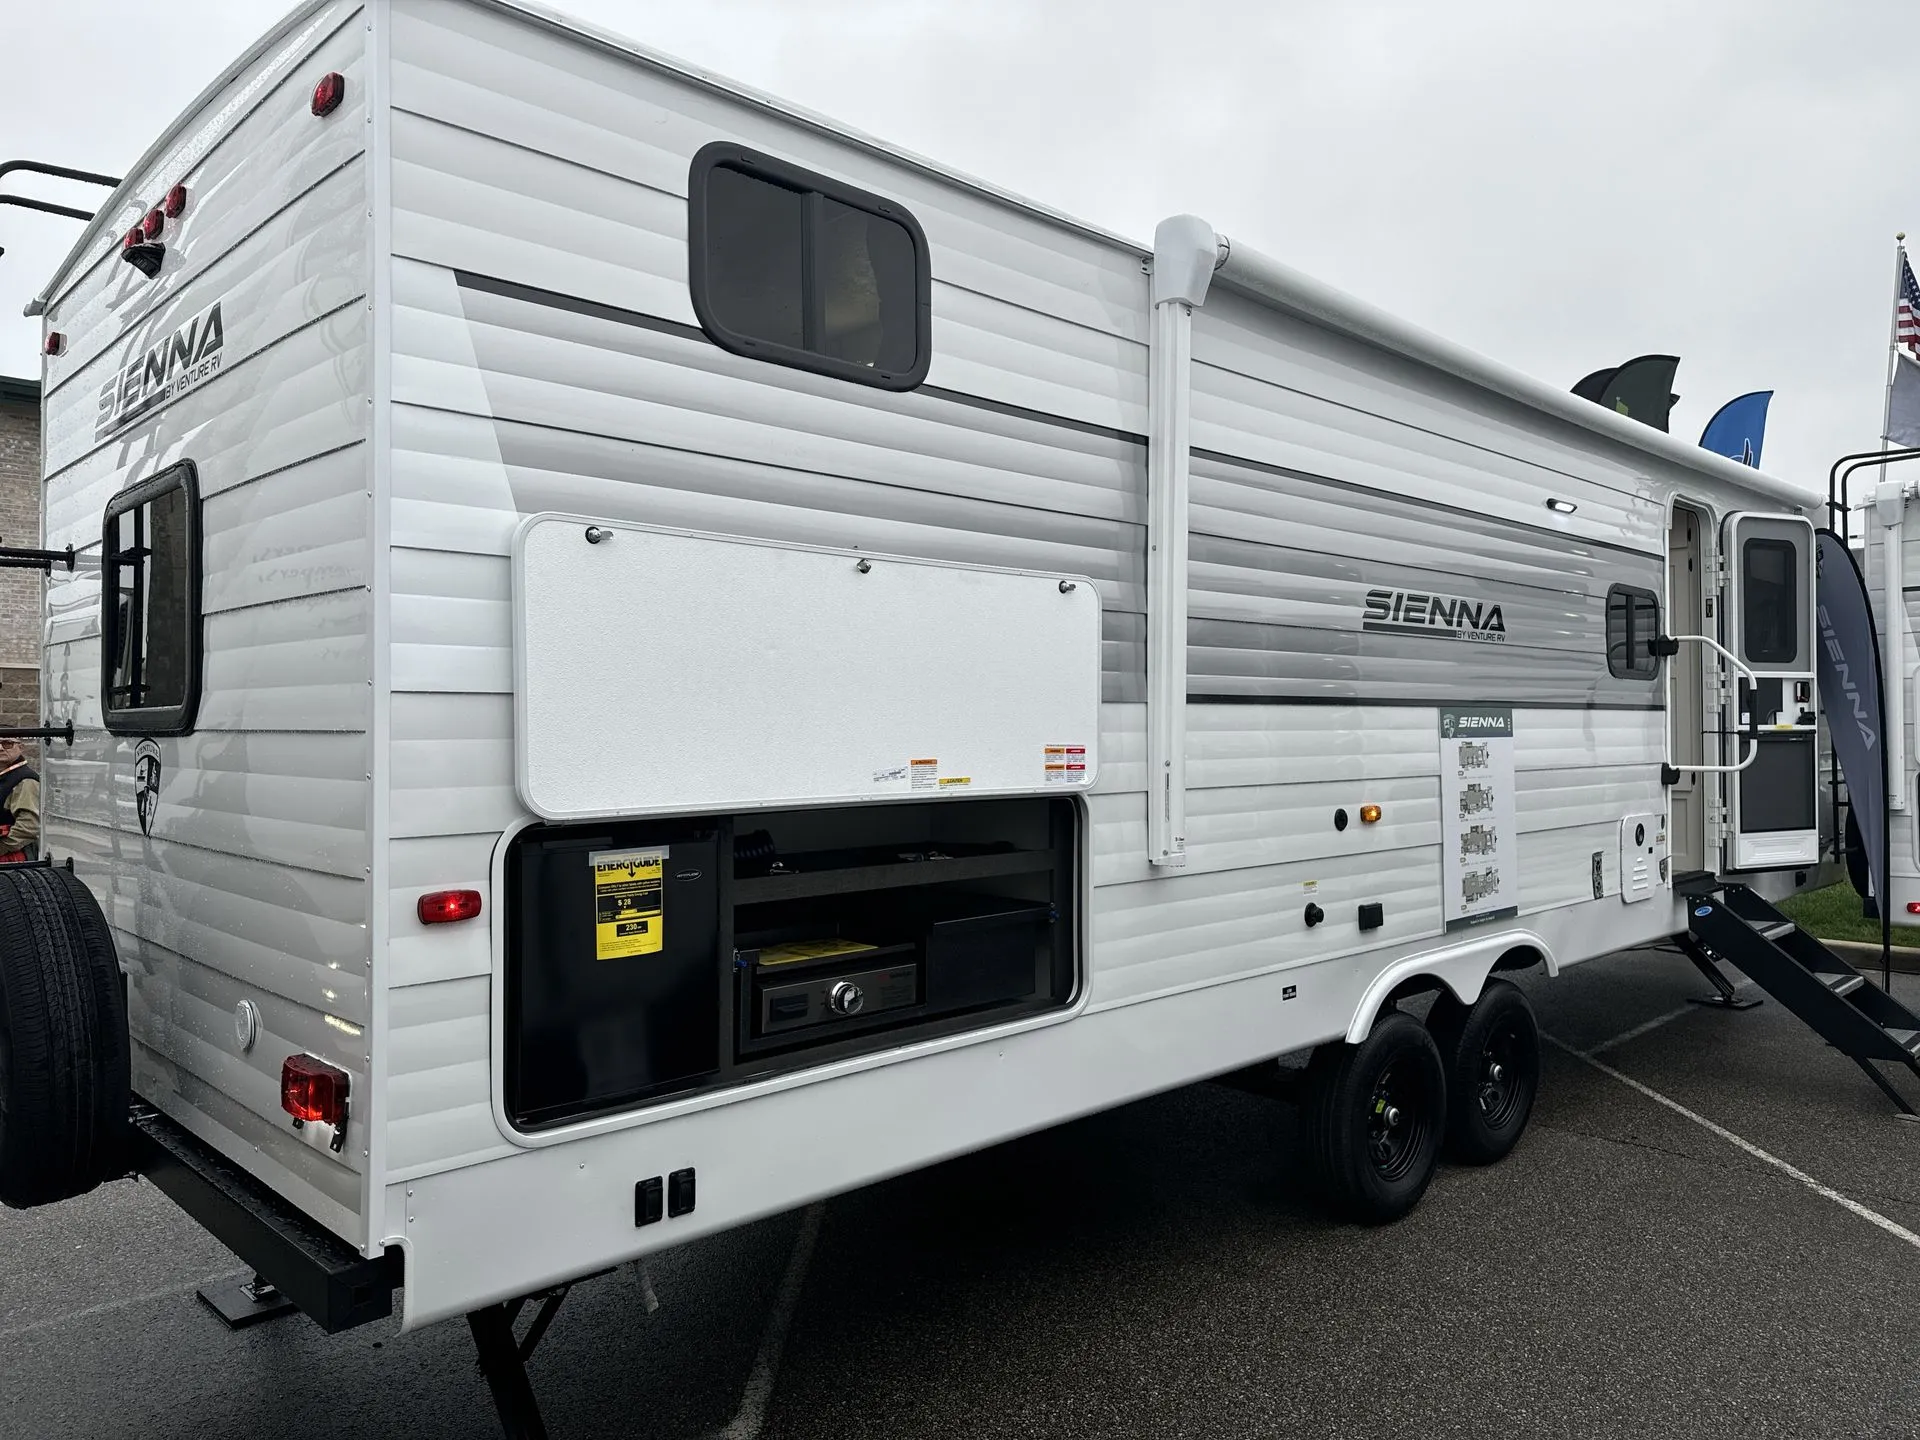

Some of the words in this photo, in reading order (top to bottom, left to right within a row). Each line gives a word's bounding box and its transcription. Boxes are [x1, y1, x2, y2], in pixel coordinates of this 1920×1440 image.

[95, 301, 223, 428] SIENNA
[165, 384, 176, 399] BY
[177, 361, 209, 392] VENTURE
[210, 352, 222, 372] RV
[1363, 589, 1505, 632] SIENNA
[1457, 630, 1467, 639] BY
[1467, 631, 1496, 642] VENTURE
[1496, 634, 1505, 642] RV
[1817, 604, 1876, 750] SIENNA
[1458, 716, 1505, 728] SIENNA
[136, 744, 159, 758] VENTURE
[623, 898, 632, 906] 28
[625, 923, 638, 931] 230
